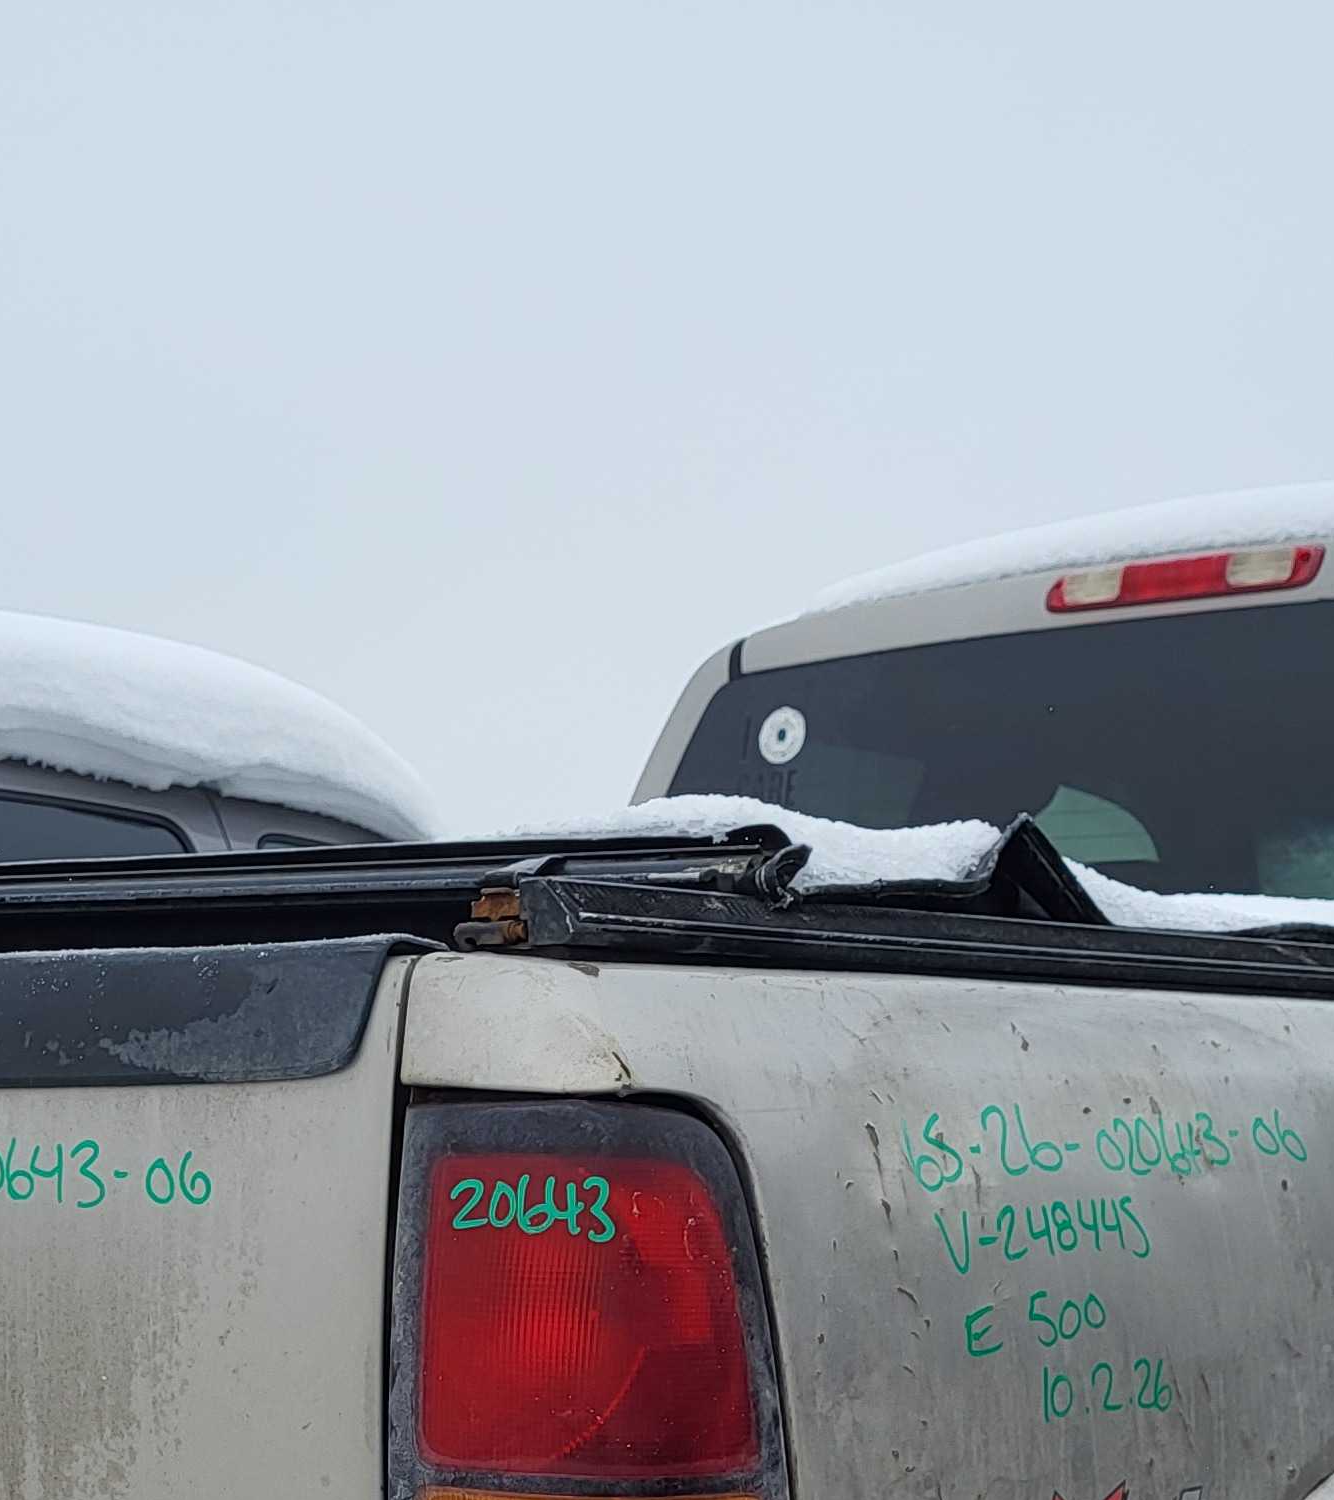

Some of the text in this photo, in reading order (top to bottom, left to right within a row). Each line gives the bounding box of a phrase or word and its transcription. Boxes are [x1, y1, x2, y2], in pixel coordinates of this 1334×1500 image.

[450, 1174, 616, 1243] 20643
[965, 1290, 1106, 1357] E 500
